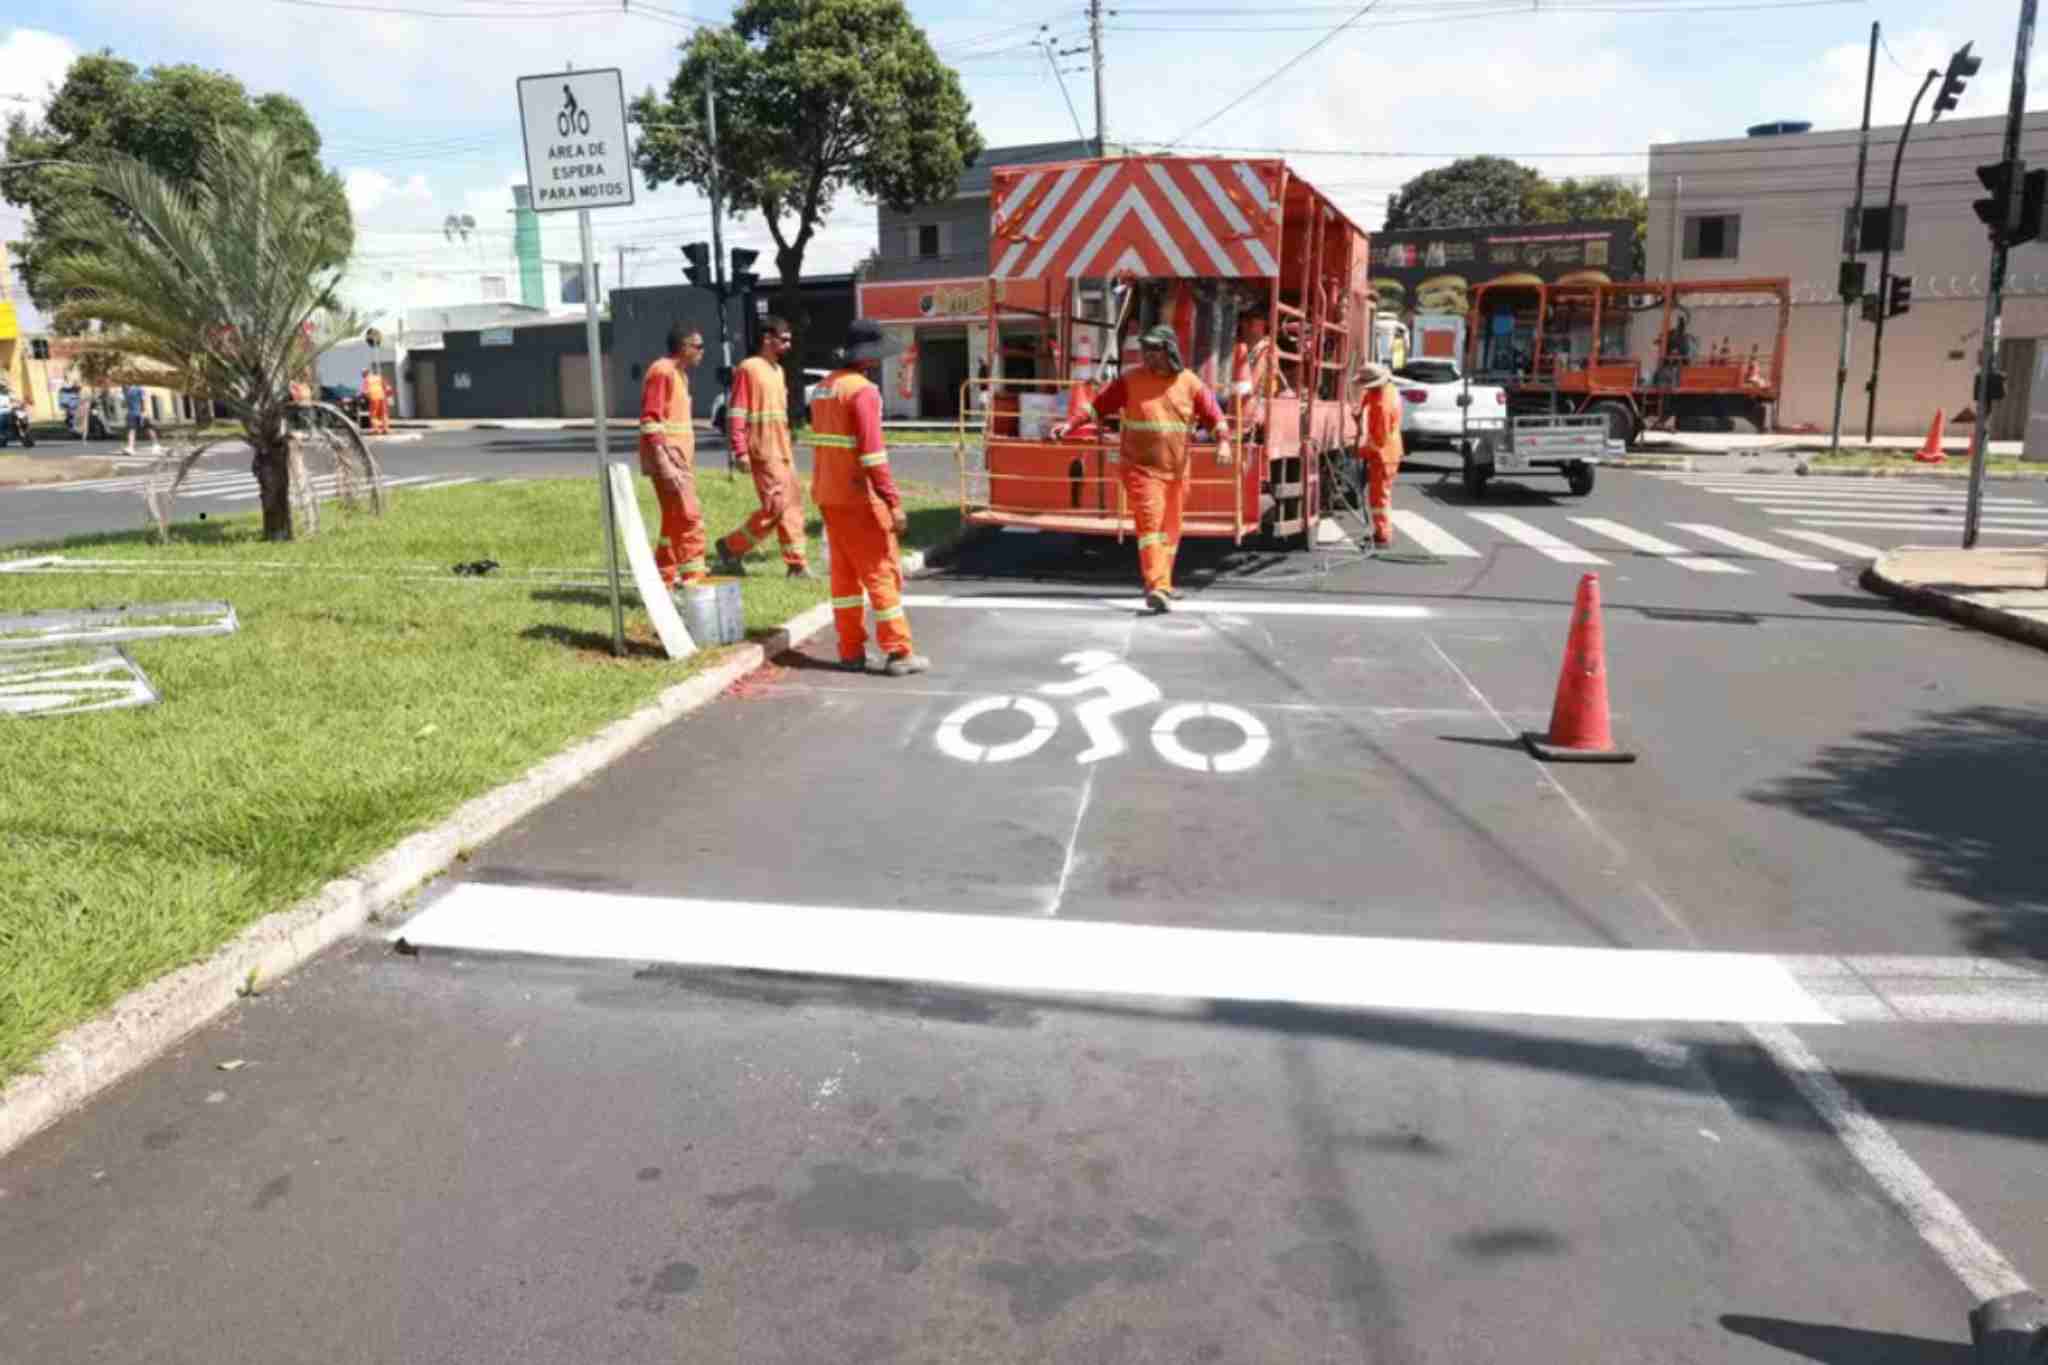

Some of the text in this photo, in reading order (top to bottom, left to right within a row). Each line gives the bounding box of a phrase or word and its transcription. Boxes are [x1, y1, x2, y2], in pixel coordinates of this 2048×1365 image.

[588, 141, 606, 156] DE
[552, 163, 605, 180] ESPERA
[539, 182, 623, 201] PARA MOTOS
